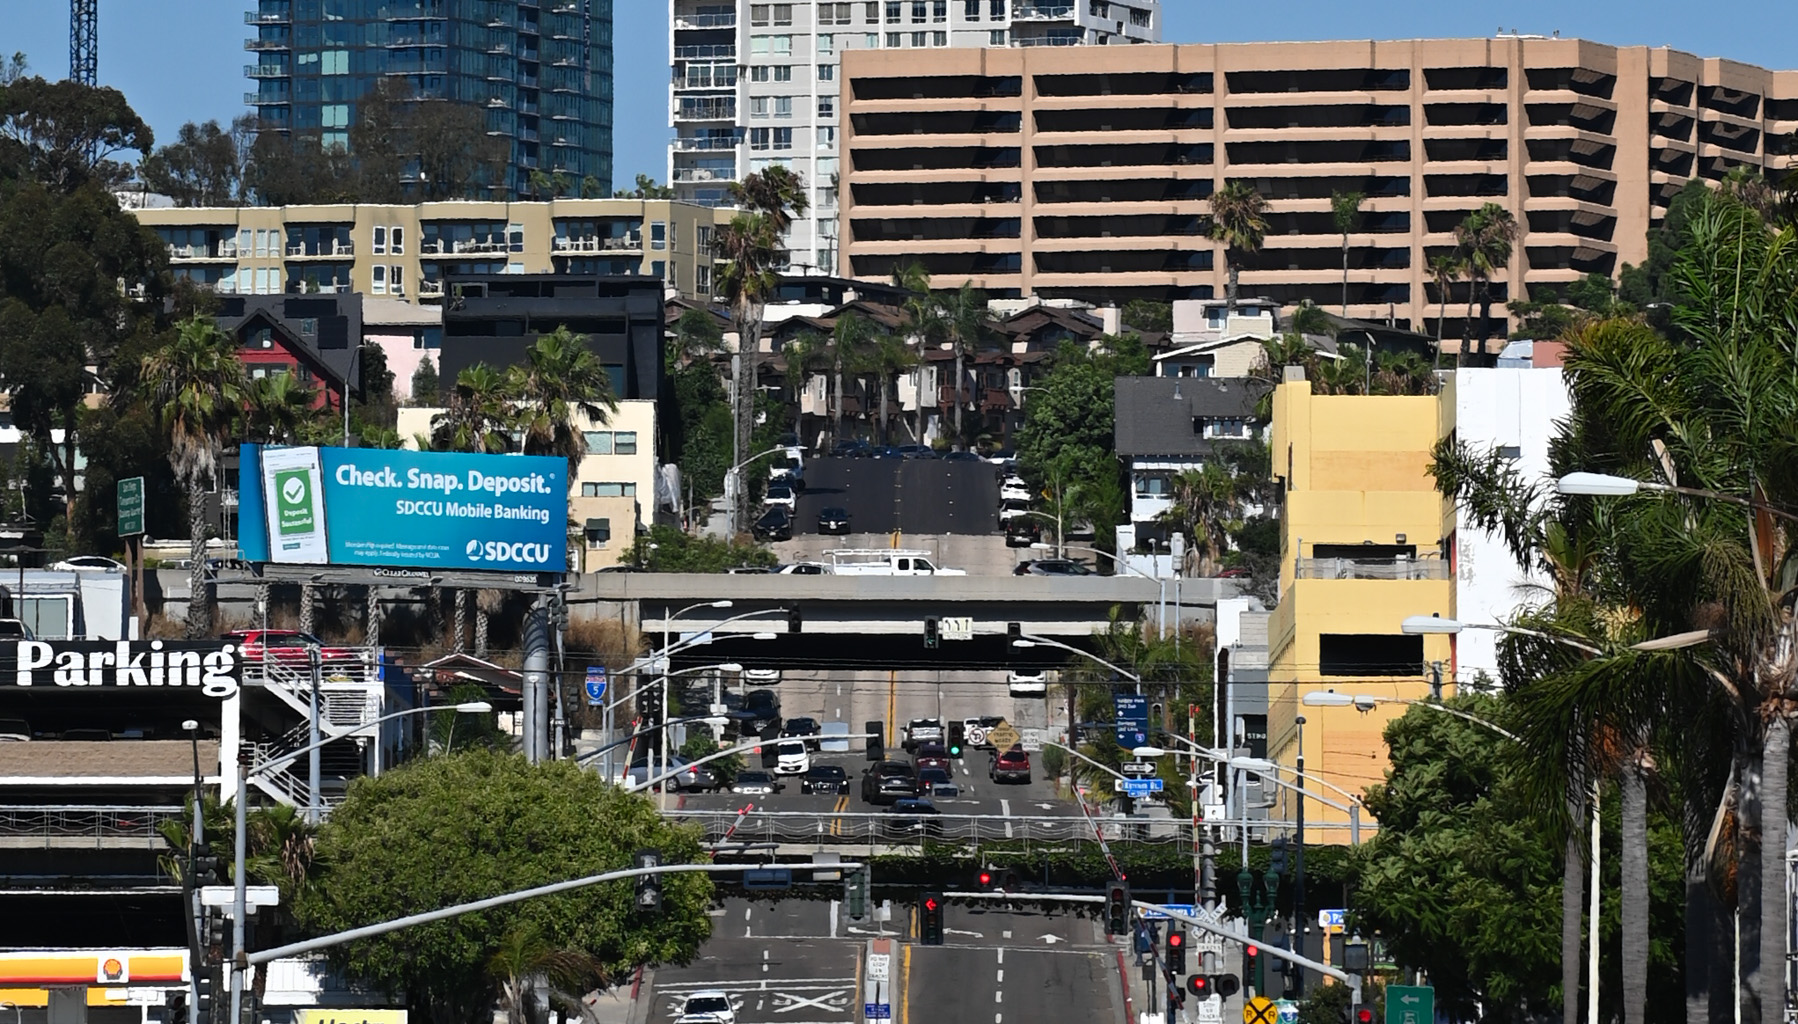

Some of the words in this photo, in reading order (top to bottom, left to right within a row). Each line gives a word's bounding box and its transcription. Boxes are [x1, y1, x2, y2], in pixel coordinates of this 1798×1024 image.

[335, 464, 403, 488] Check.
[407, 468, 464, 495] Snap.
[468, 470, 551, 497] Deposit.
[396, 500, 443, 516] SDCCU
[446, 501, 493, 519] Mobile
[494, 505, 550, 524] Banking
[484, 541, 549, 563] SDCCU
[16, 640, 238, 697] Parking
[593, 686, 599, 695] 5
[1245, 1009, 1253, 1019] R
[1268, 1010, 1276, 1020] R
